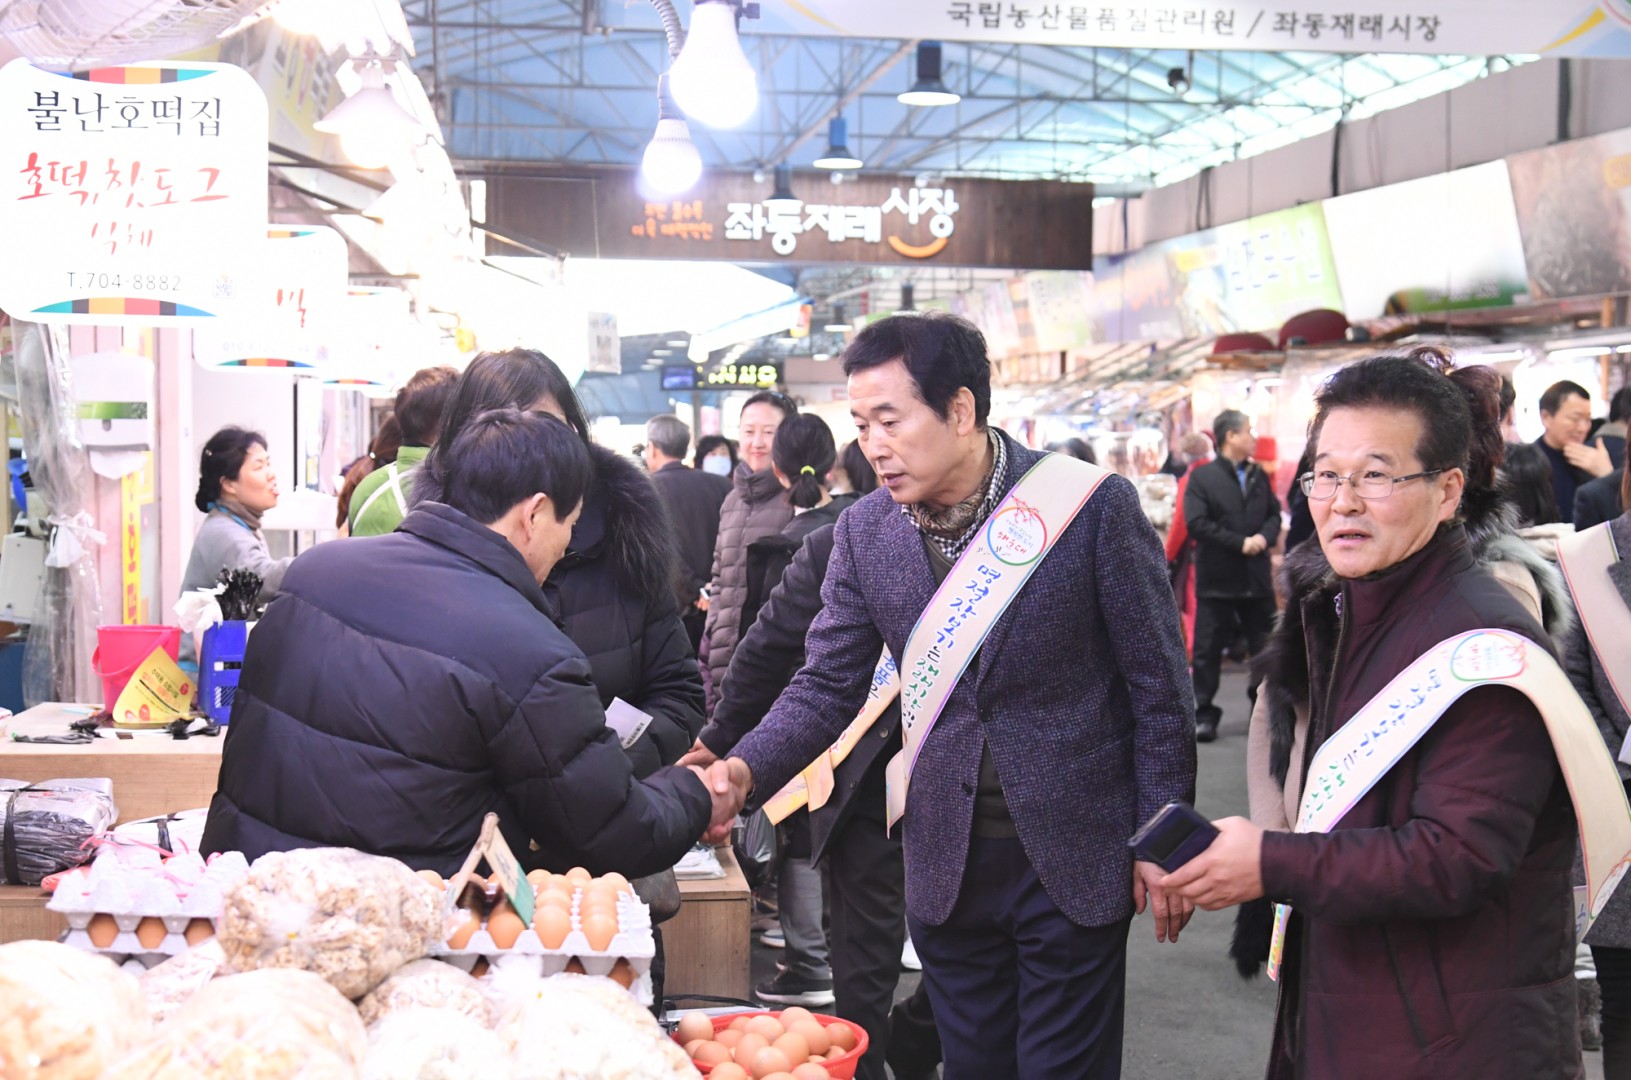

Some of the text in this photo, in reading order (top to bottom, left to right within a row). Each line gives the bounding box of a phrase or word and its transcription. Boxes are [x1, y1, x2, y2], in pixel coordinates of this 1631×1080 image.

[946, 1, 1235, 36] 국립농산물품질관리원
[1272, 11, 1441, 42] 좌동재래시장
[27, 91, 222, 137] 불난호떡집
